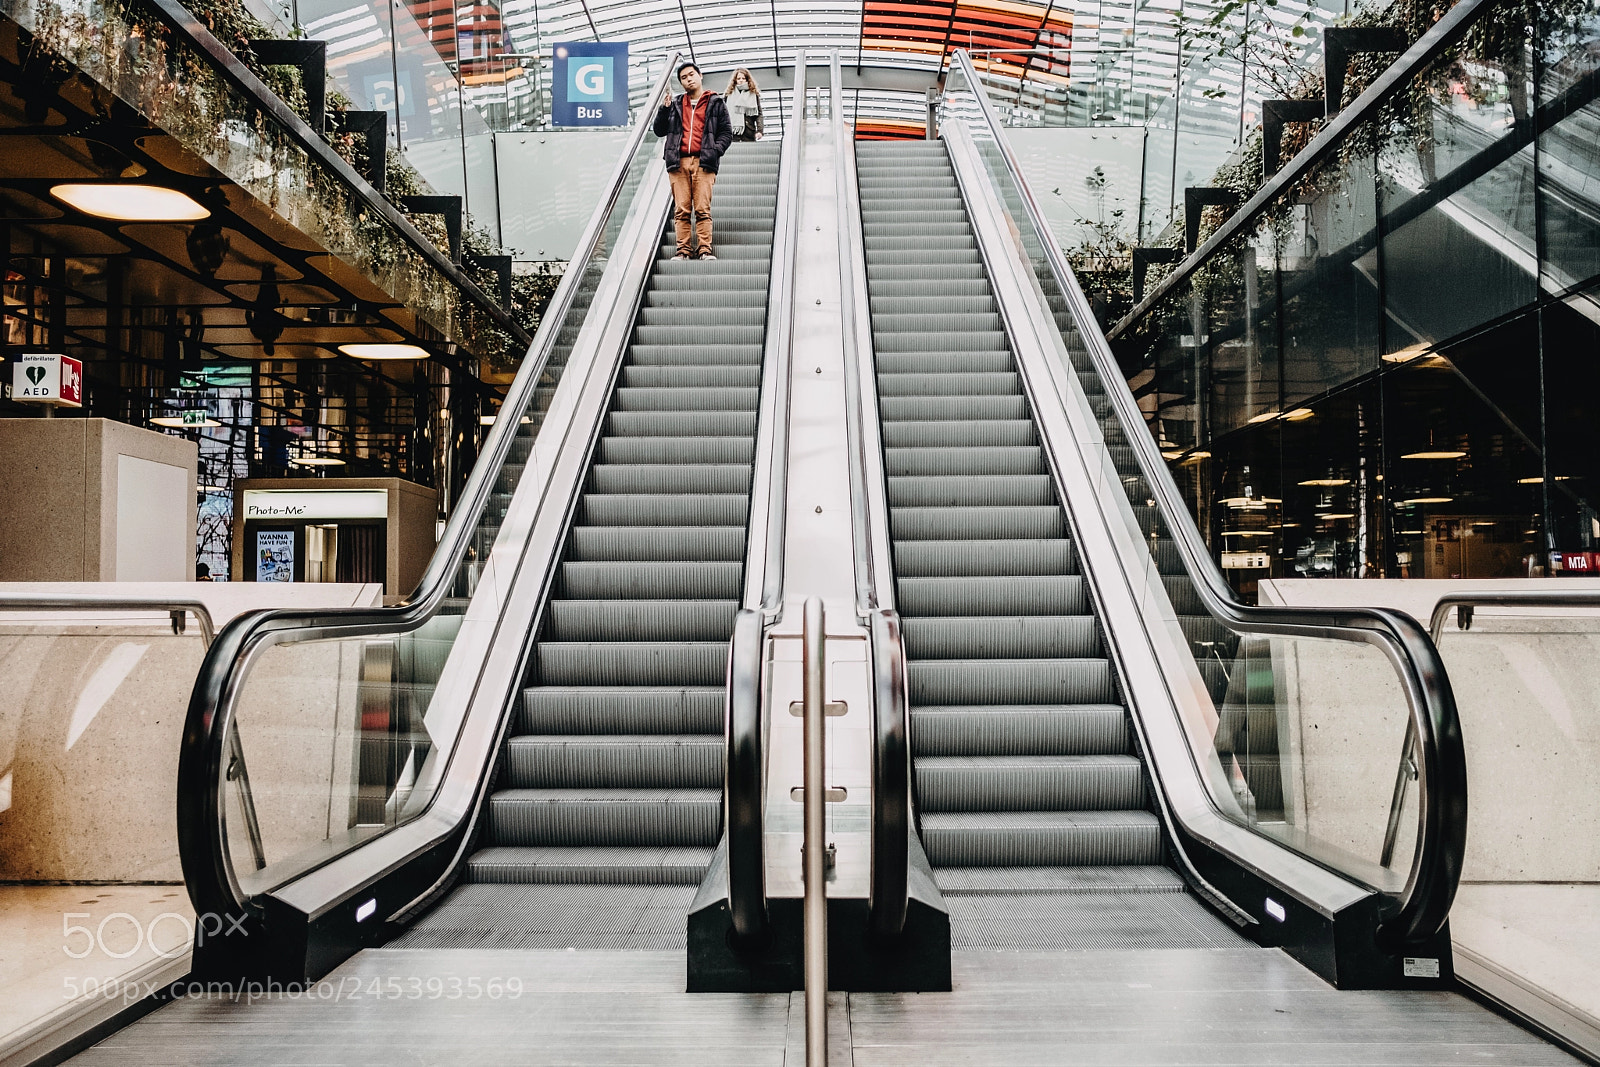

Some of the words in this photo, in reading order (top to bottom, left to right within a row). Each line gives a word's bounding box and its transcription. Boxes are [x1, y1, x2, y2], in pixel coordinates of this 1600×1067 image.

[575, 63, 605, 96] G
[577, 106, 603, 119] Bus
[23, 387, 49, 395] AED
[1568, 556, 1588, 569] MTA
